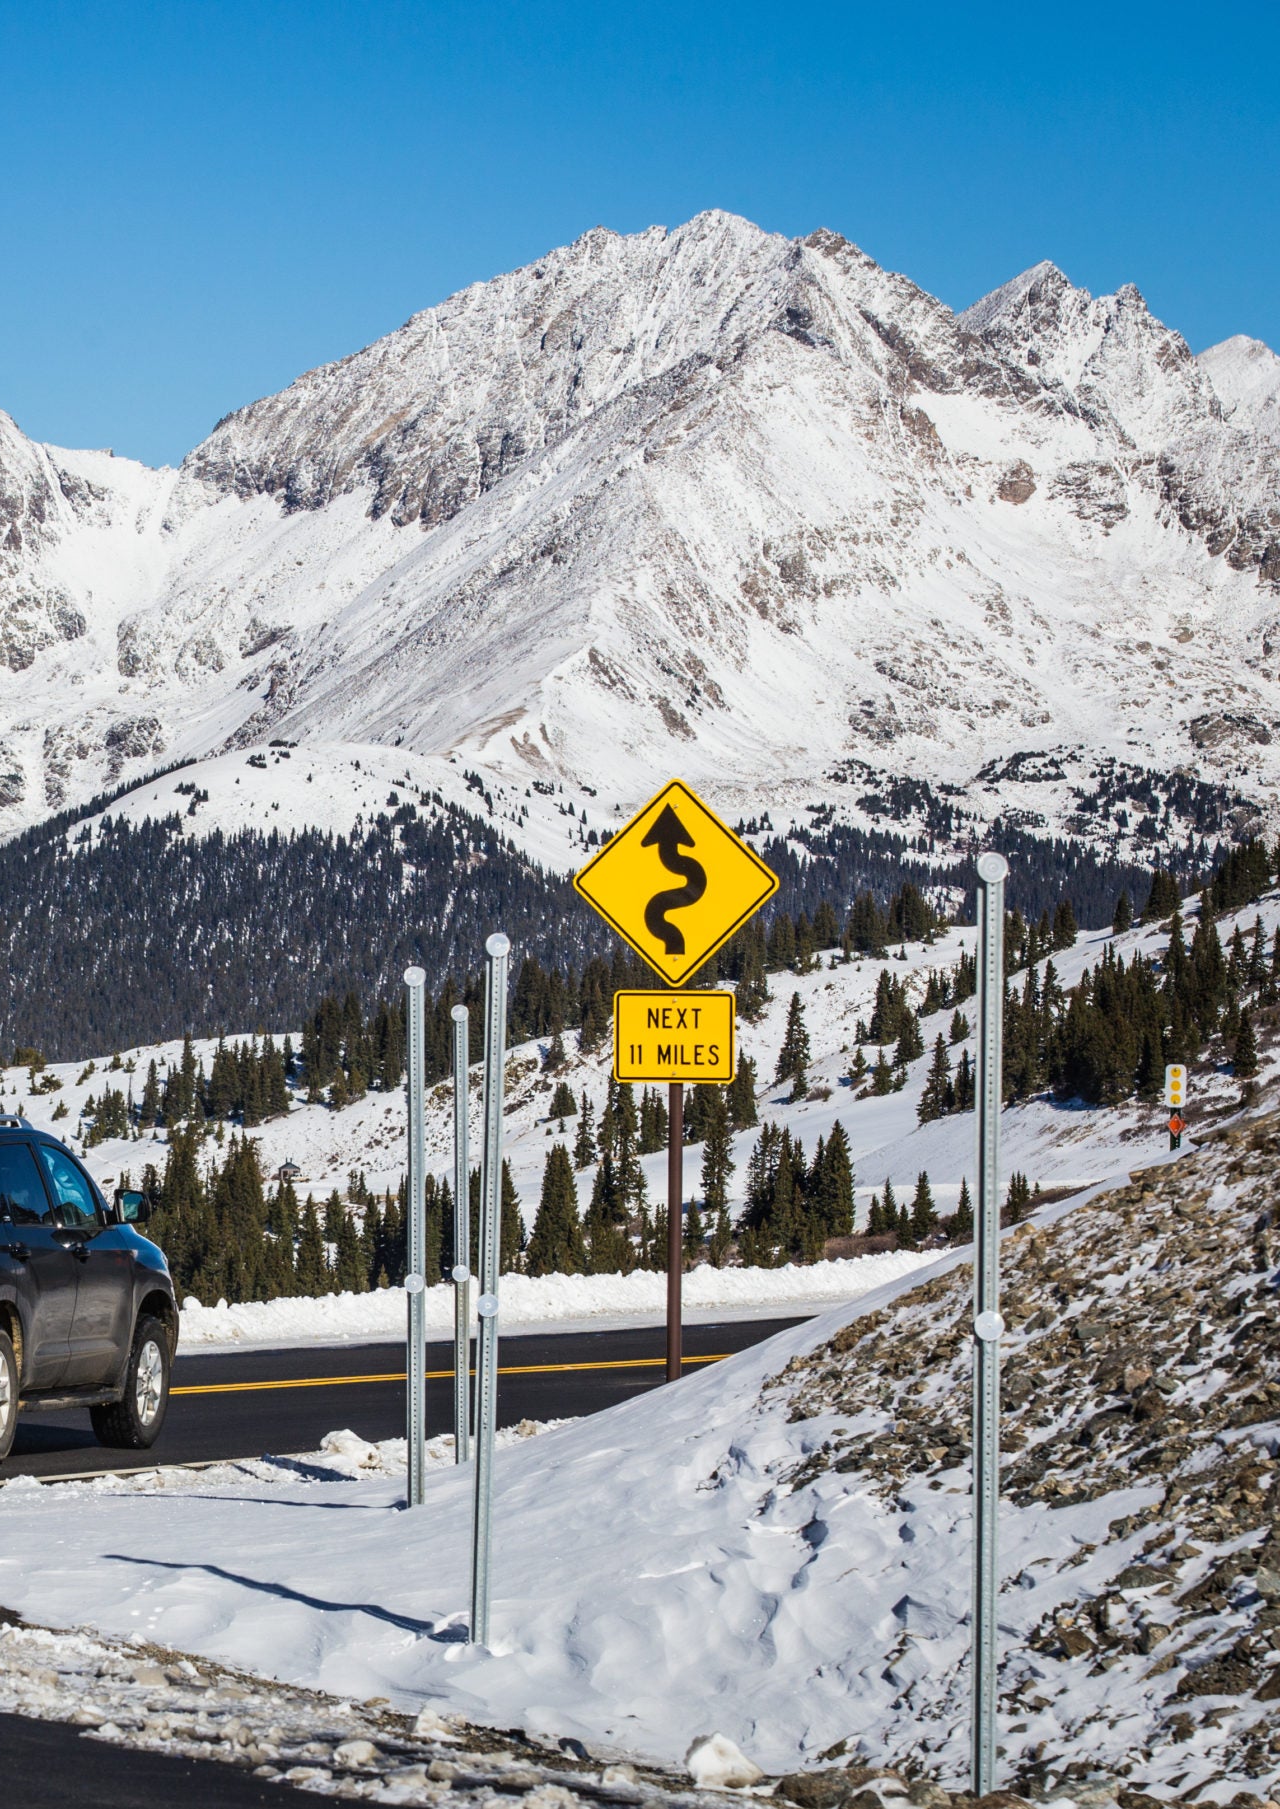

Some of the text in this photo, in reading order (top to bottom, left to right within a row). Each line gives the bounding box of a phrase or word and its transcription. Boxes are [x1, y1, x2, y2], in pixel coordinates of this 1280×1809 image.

[647, 1008, 701, 1029] NEXT
[630, 1044, 719, 1066] 11 MILES
